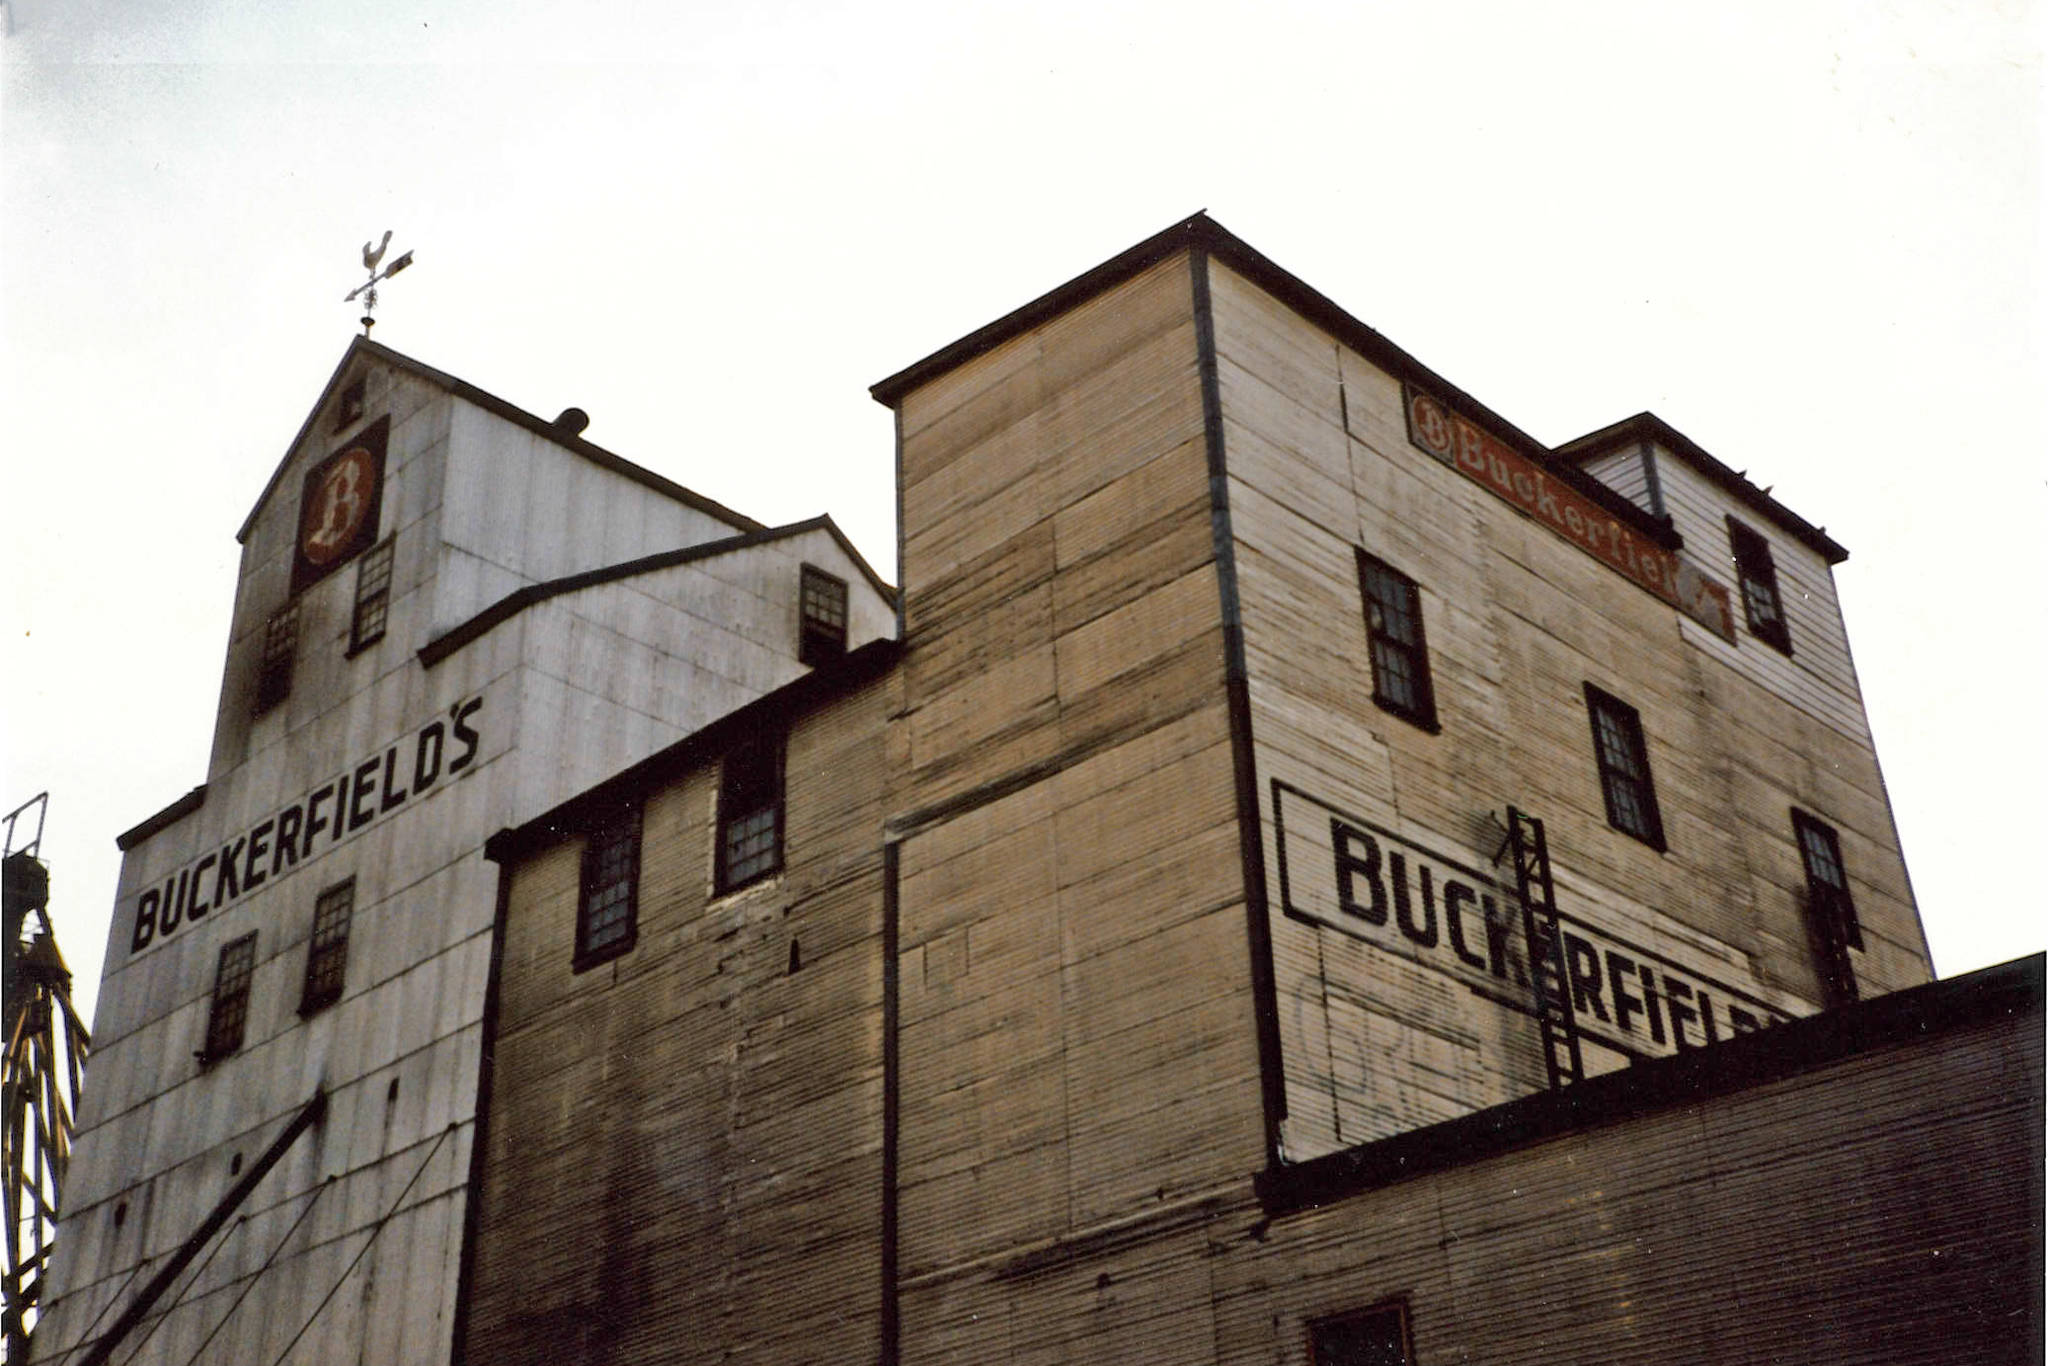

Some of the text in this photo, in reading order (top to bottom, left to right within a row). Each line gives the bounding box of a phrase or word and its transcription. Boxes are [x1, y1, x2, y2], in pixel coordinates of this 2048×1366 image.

[309, 457, 362, 547] B
[1456, 421, 1683, 598] Buckerfiel
[131, 695, 482, 954] BUCKERFIELD'S
